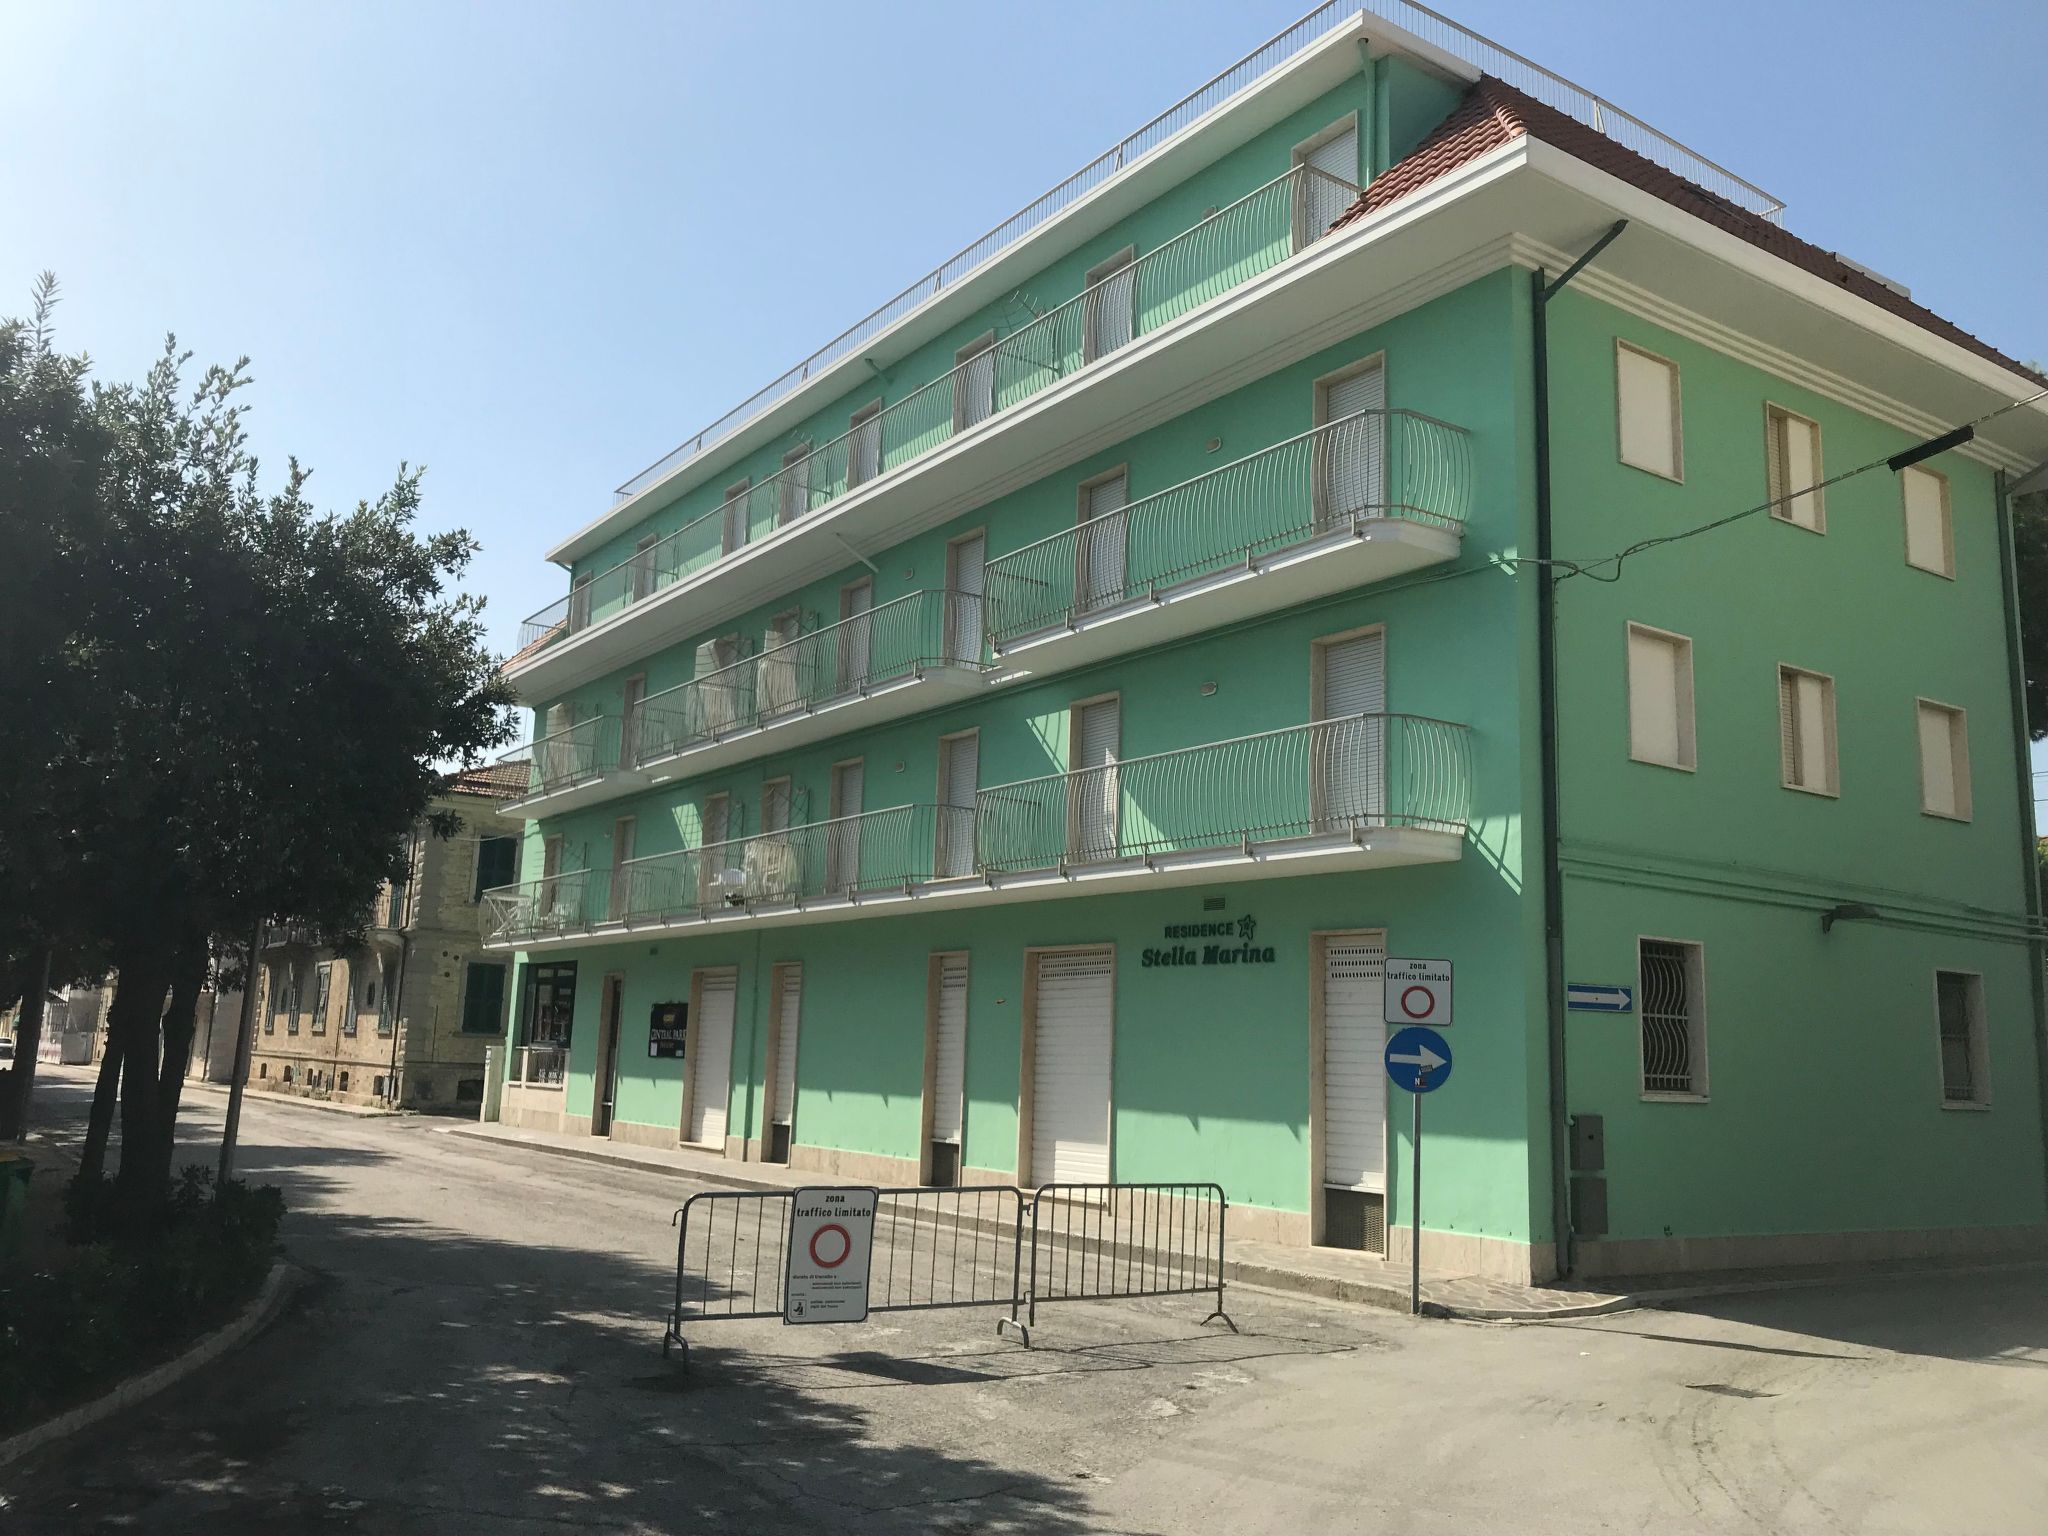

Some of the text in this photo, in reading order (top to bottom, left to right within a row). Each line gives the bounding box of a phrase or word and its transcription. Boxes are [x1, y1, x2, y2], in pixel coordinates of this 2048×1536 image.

[1164, 922, 1234, 939] RESIDENCE
[1141, 942, 1276, 968] Stella Marina
[1387, 971, 1450, 982] traffico limitato
[825, 1195, 845, 1203] zona
[797, 1207, 871, 1217] traffico limitato
